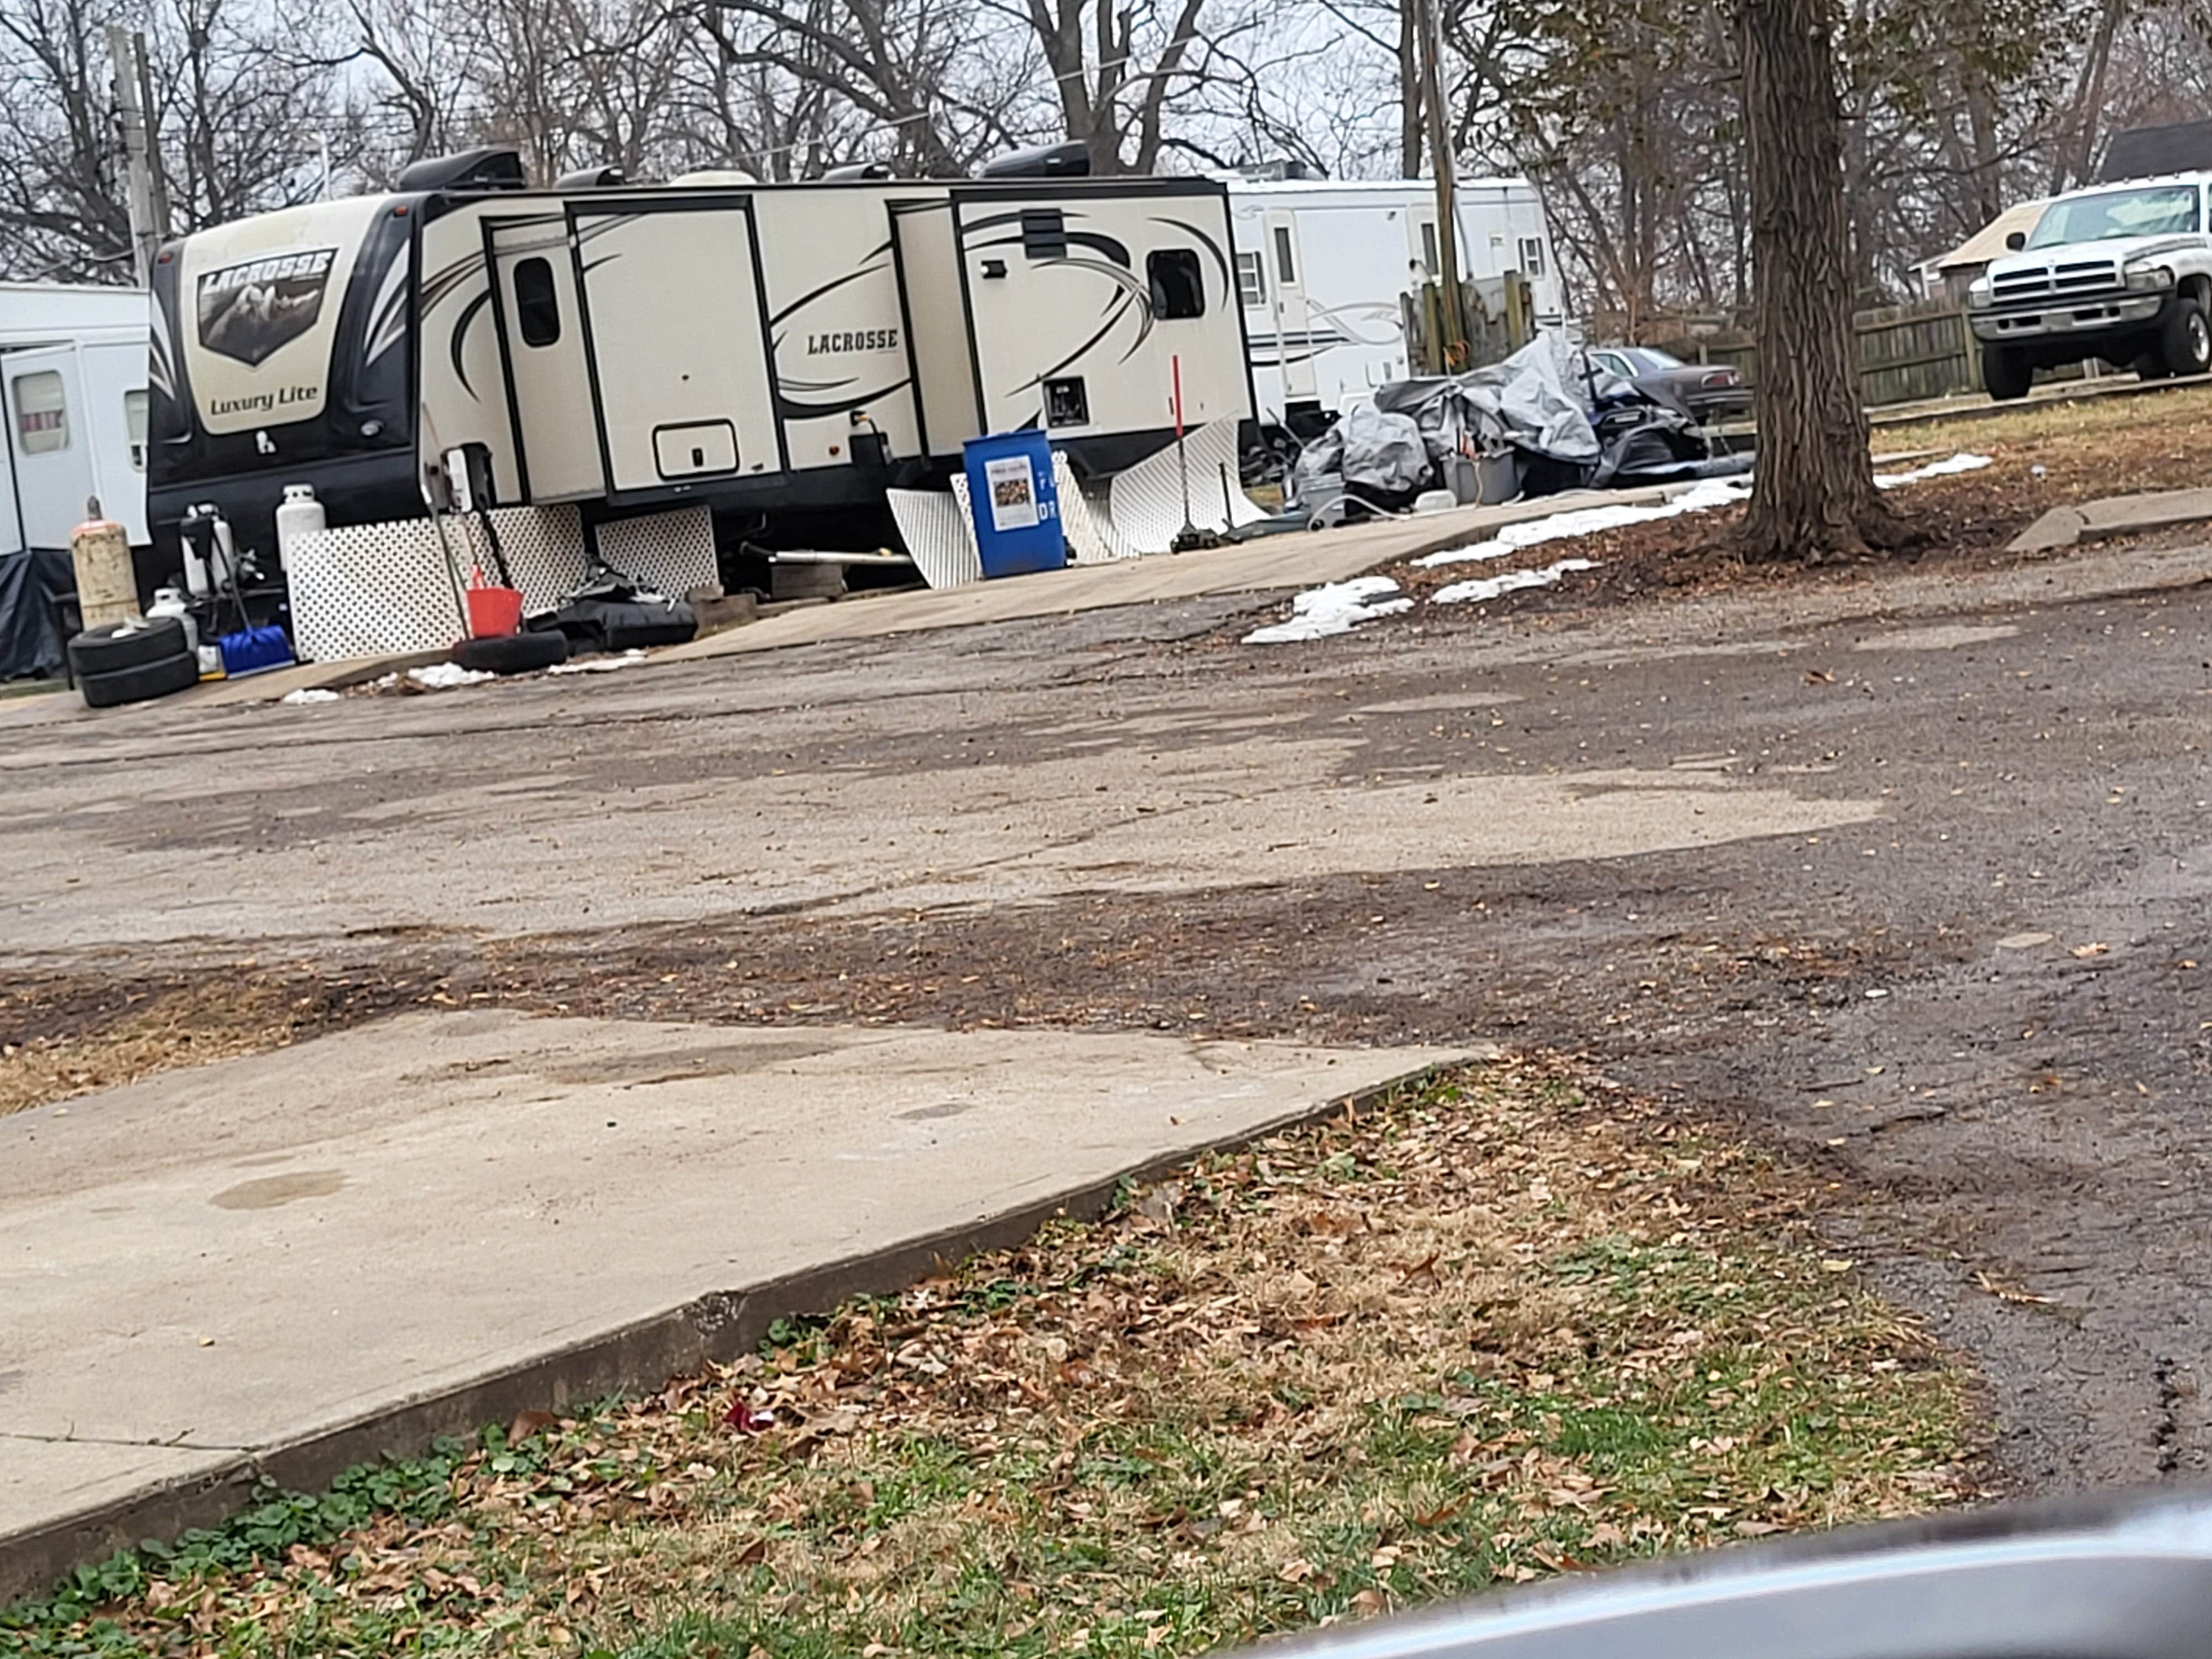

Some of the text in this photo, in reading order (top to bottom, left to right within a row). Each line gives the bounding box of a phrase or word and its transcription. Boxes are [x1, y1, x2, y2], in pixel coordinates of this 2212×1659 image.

[202, 252, 332, 295] LACROSSE
[808, 329, 898, 355] LACROSSE
[211, 385, 317, 415] Luxury Lite
